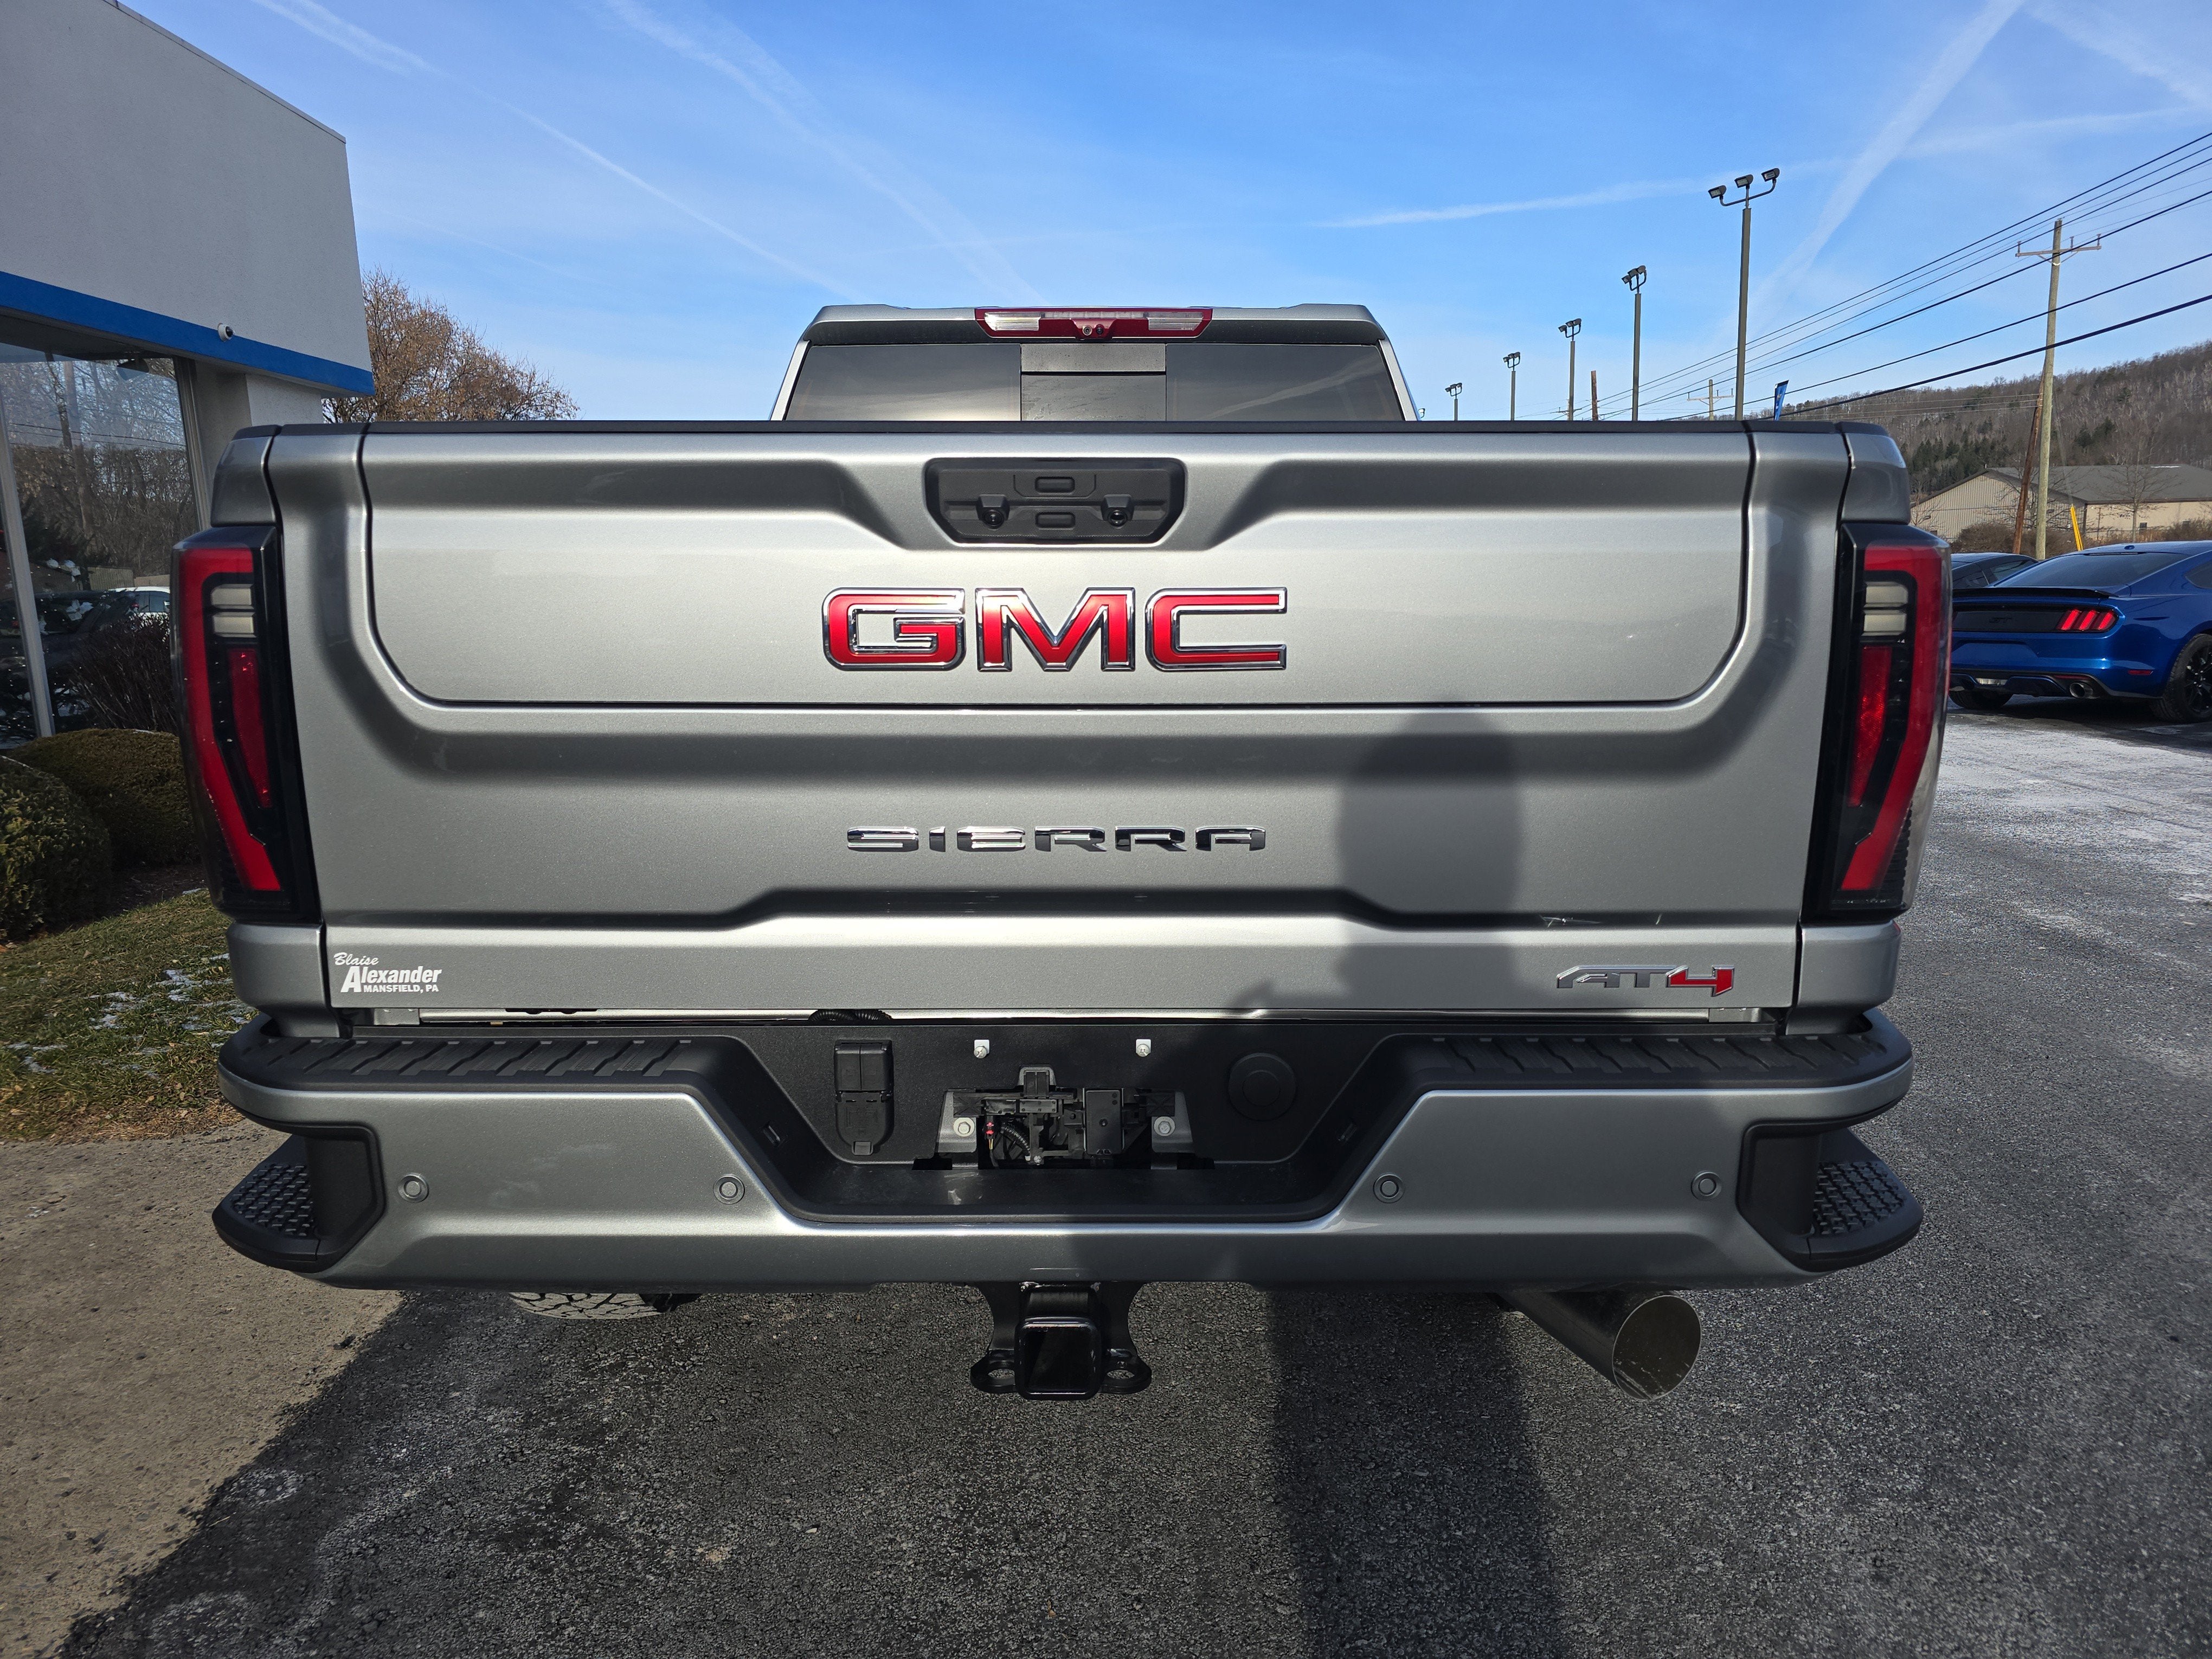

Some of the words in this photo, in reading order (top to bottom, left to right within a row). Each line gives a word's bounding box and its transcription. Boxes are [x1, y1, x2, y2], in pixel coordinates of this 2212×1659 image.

[822, 587, 1288, 671] GMC
[847, 826, 1266, 852] SIERRA
[333, 952, 379, 966] Blaise
[340, 966, 442, 993] Alexander
[363, 985, 424, 994] MANSFIELD,
[1557, 964, 1735, 998] AT4
